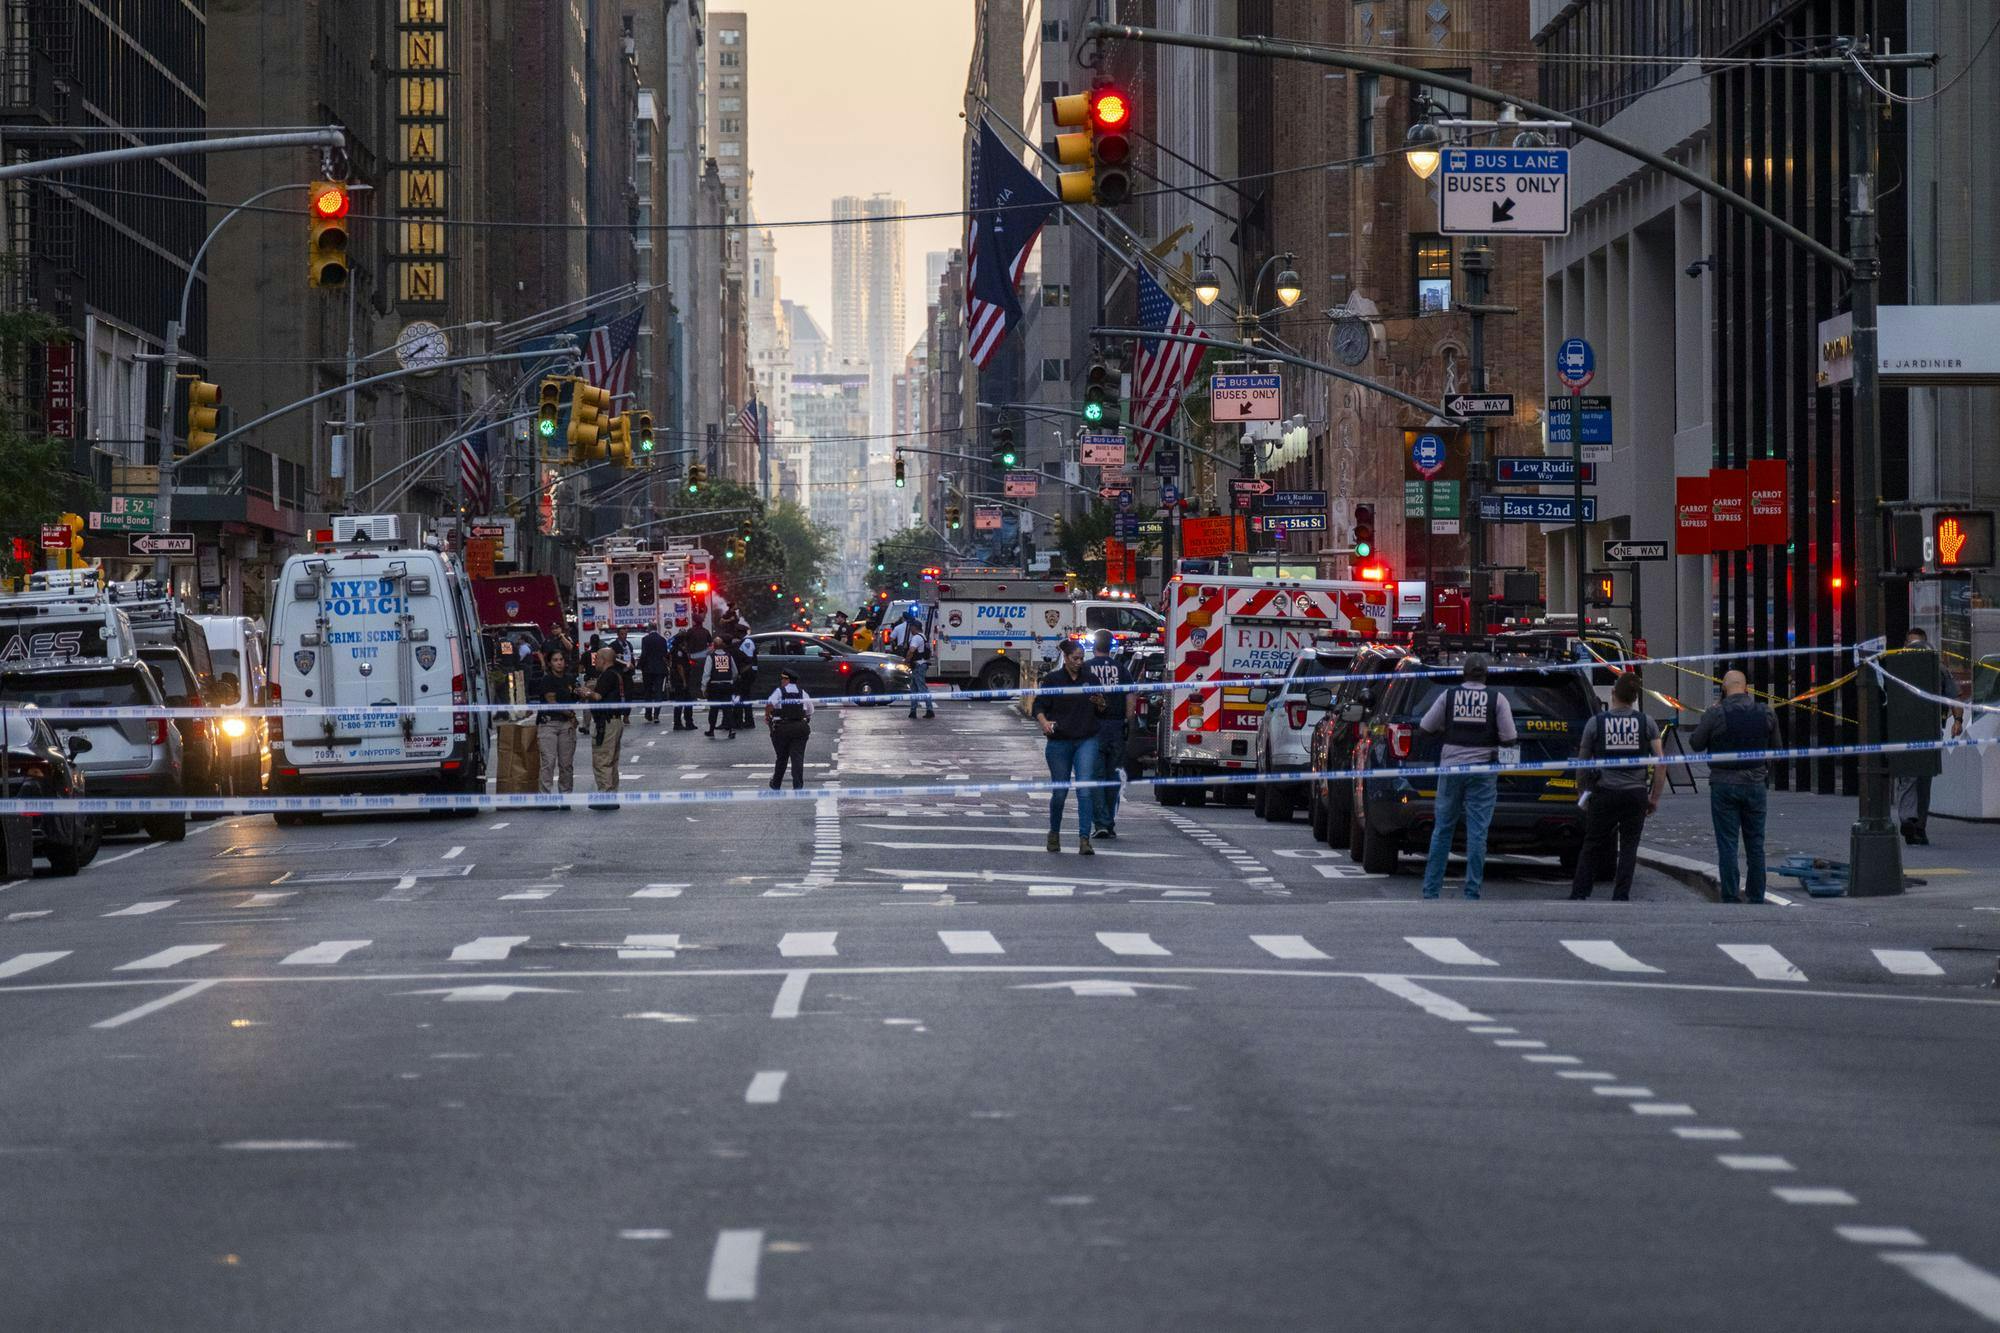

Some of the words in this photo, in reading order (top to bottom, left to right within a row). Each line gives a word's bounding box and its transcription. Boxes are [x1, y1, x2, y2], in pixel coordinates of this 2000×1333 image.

[1475, 155, 1507, 168] BUS
[1513, 156, 1559, 168] LANE
[1448, 176, 1506, 192] BUSES
[1516, 177, 1560, 193] ONLY
[1878, 359, 1889, 368] E
[1896, 359, 1962, 368] JARDINIER
[1215, 390, 1248, 400] BUSES
[1253, 390, 1277, 399] ONLY
[1455, 401, 1474, 410] ONE
[1484, 401, 1505, 410] WAY
[1550, 398, 1571, 410] M101
[1550, 413, 1571, 425] M102
[1550, 429, 1572, 441] M103
[1514, 462, 1539, 472] Lew
[1538, 473, 1554, 481] Way
[123, 500, 128, 512] E
[132, 500, 144, 513] 52
[1713, 498, 1742, 506] CARROT
[1504, 503, 1533, 515] East
[1537, 503, 1571, 516] 52nd
[1753, 506, 1782, 515] EXPRESS
[103, 515, 124, 524] Israel
[126, 515, 150, 525] Bonds
[1268, 519, 1289, 528] Et
[1291, 519, 1309, 528] 51st
[1311, 518, 1321, 527] St
[1714, 514, 1742, 522] EXPRESS
[1146, 524, 1162, 533] 50th
[1680, 520, 1707, 528] EXPRESS
[141, 540, 159, 549] ONE
[168, 540, 187, 549] WAY
[1613, 547, 1632, 556] ONE
[1640, 547, 1660, 555] WAY
[331, 579, 394, 598] NYPD
[1602, 580, 1611, 598] 4
[318, 597, 409, 616] POLICE
[977, 606, 1026, 618] POLICE
[1366, 605, 1386, 617] RM2
[615, 608, 634, 617] TRUCK
[327, 631, 361, 644] CRIME
[366, 629, 401, 641] SCENE
[0, 631, 83, 661] AES
[351, 646, 379, 659] UNIT
[1250, 650, 1295, 660] RESCU
[1232, 659, 1292, 670] PARAME
[1090, 665, 1119, 677] NYPD
[1099, 677, 1119, 687] LICE
[1454, 690, 1488, 706] NYPD
[337, 713, 360, 721] CRIME
[362, 712, 399, 720] STOPPERS
[1453, 705, 1487, 718] POLICE
[340, 721, 396, 730] 1-800-577-TIPS
[1526, 720, 1569, 732] POLICE
[1604, 717, 1639, 733] NYPD
[1605, 732, 1640, 745] POLICE
[315, 751, 335, 759] 7057
[358, 749, 401, 757] @NYPDTIPS
